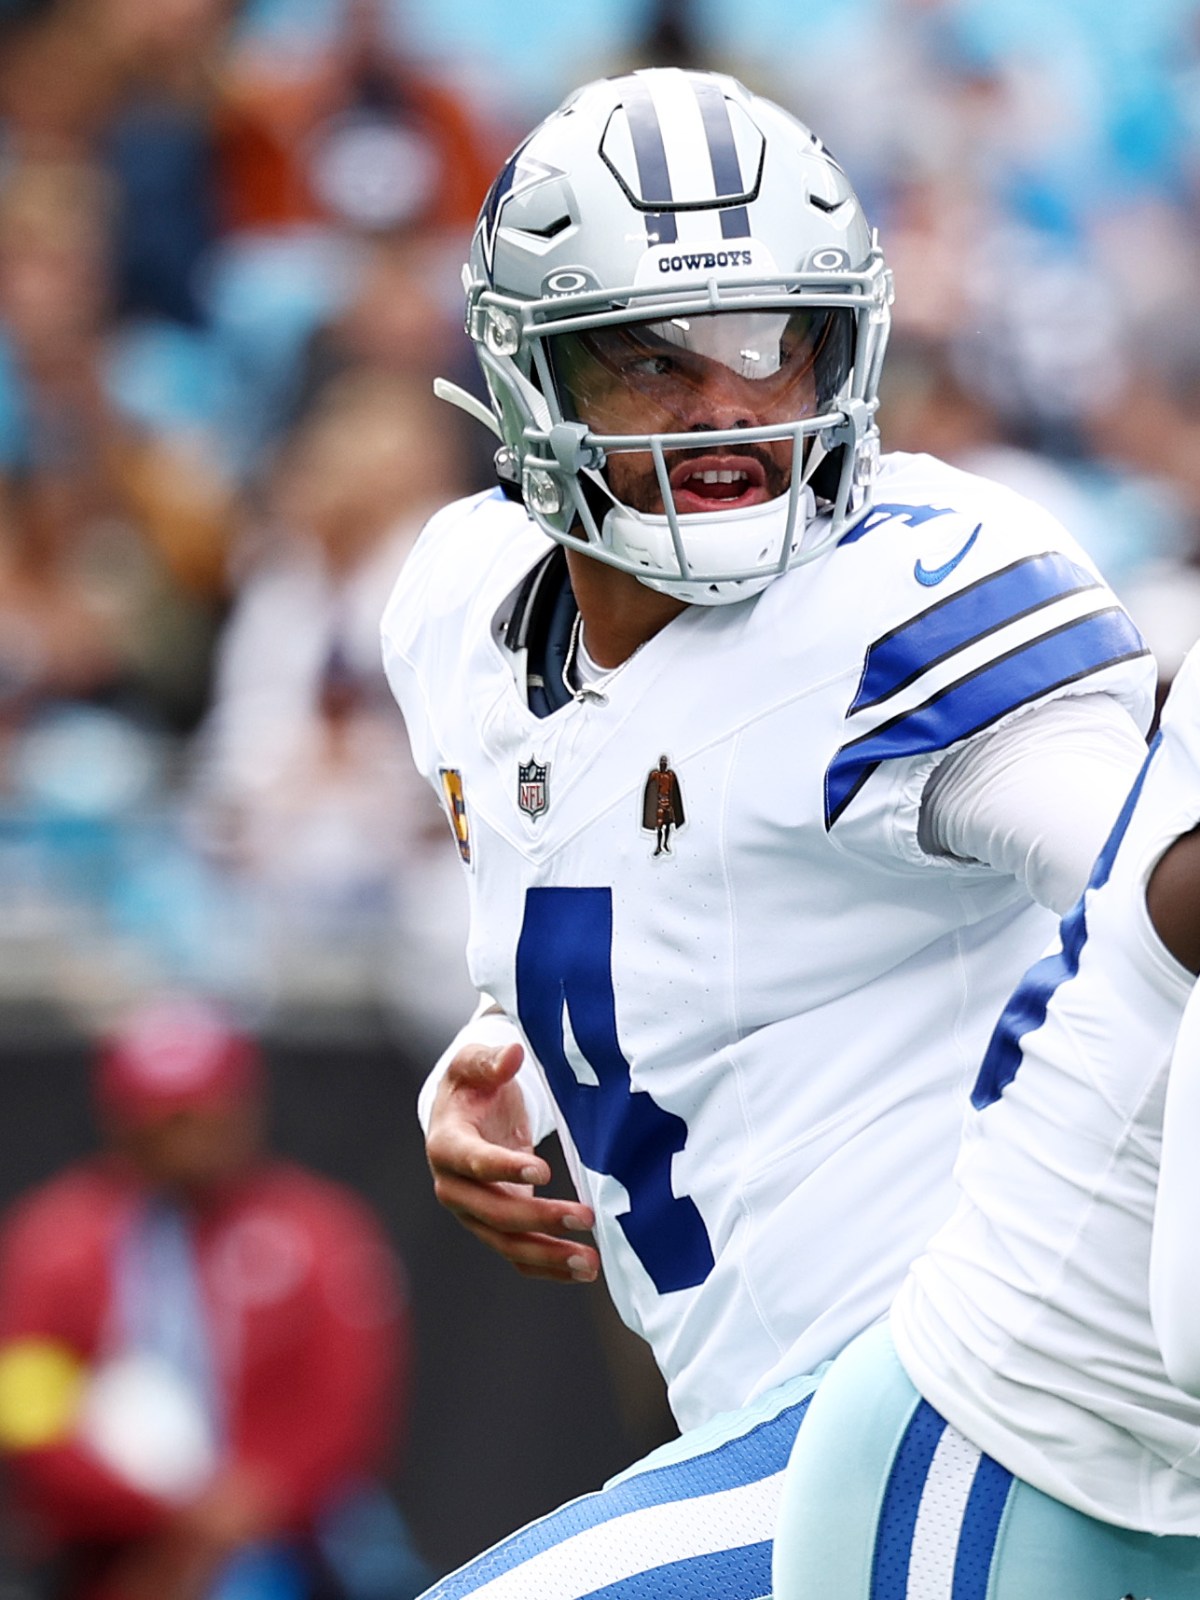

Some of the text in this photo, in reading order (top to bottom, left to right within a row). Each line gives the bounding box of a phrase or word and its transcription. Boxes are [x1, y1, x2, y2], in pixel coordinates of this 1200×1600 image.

[658, 250, 752, 273] COWBOYS
[521, 785, 545, 810] NFL
[516, 887, 715, 1294] 4
